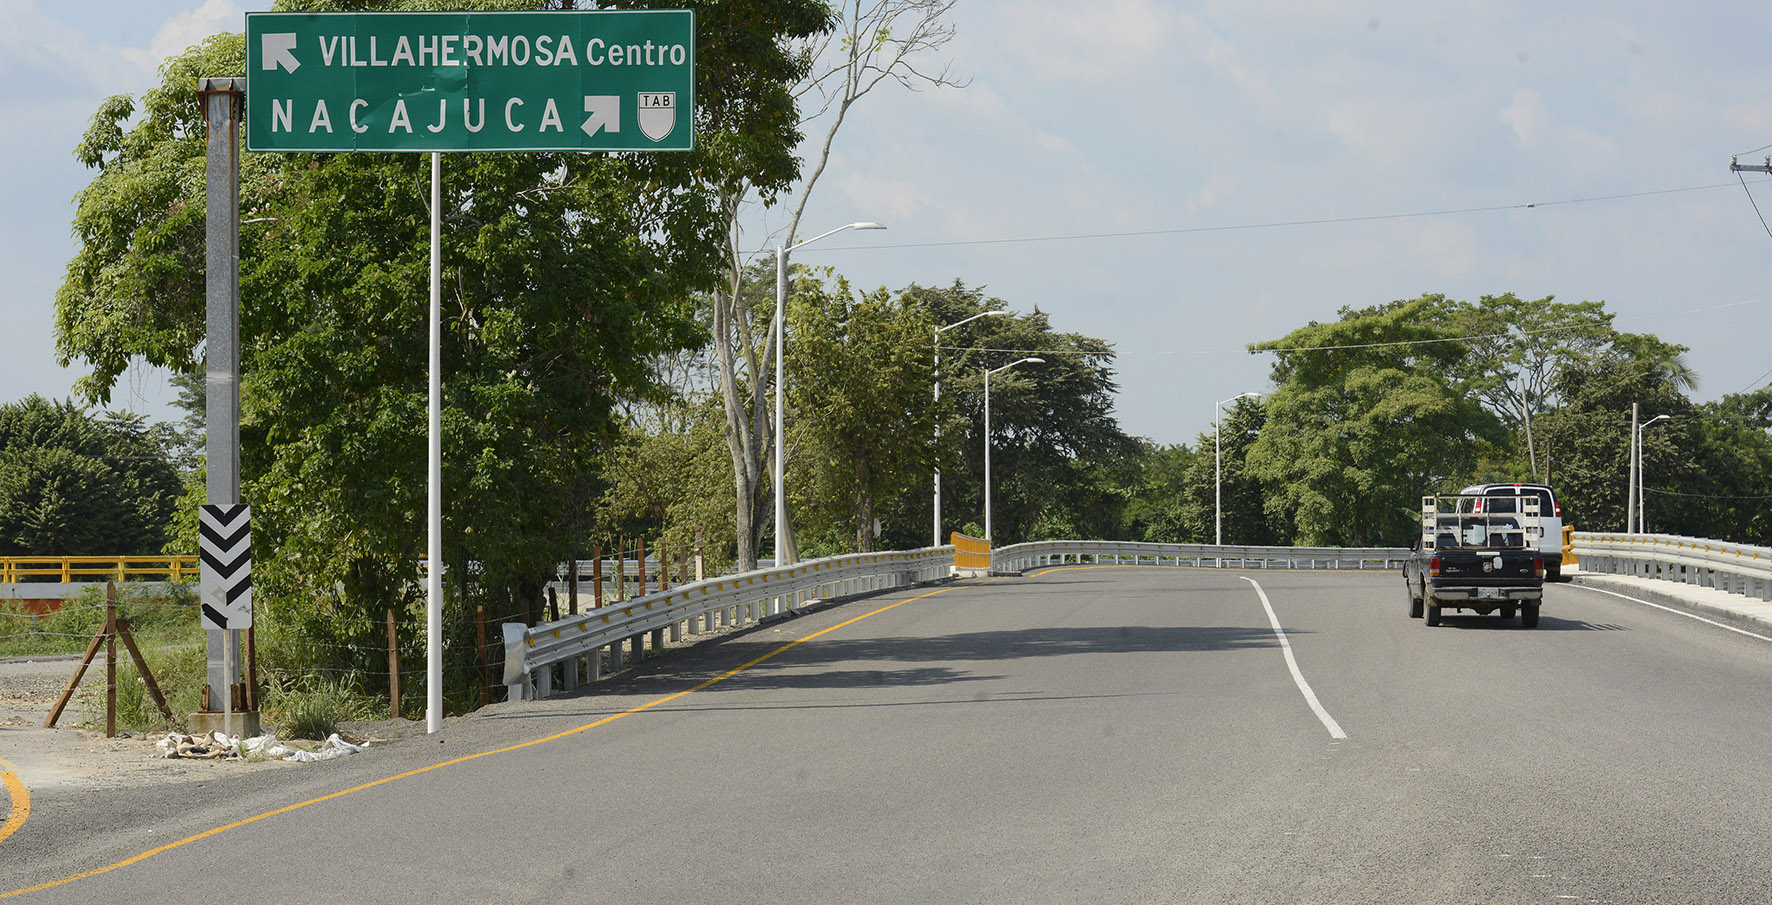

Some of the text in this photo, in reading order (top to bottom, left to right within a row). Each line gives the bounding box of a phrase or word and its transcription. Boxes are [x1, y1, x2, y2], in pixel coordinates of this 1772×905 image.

[319, 35, 686, 67] VILLAHERMOSA Centro
[272, 98, 564, 134] NACAJUCA
[643, 95, 670, 107] TAB
